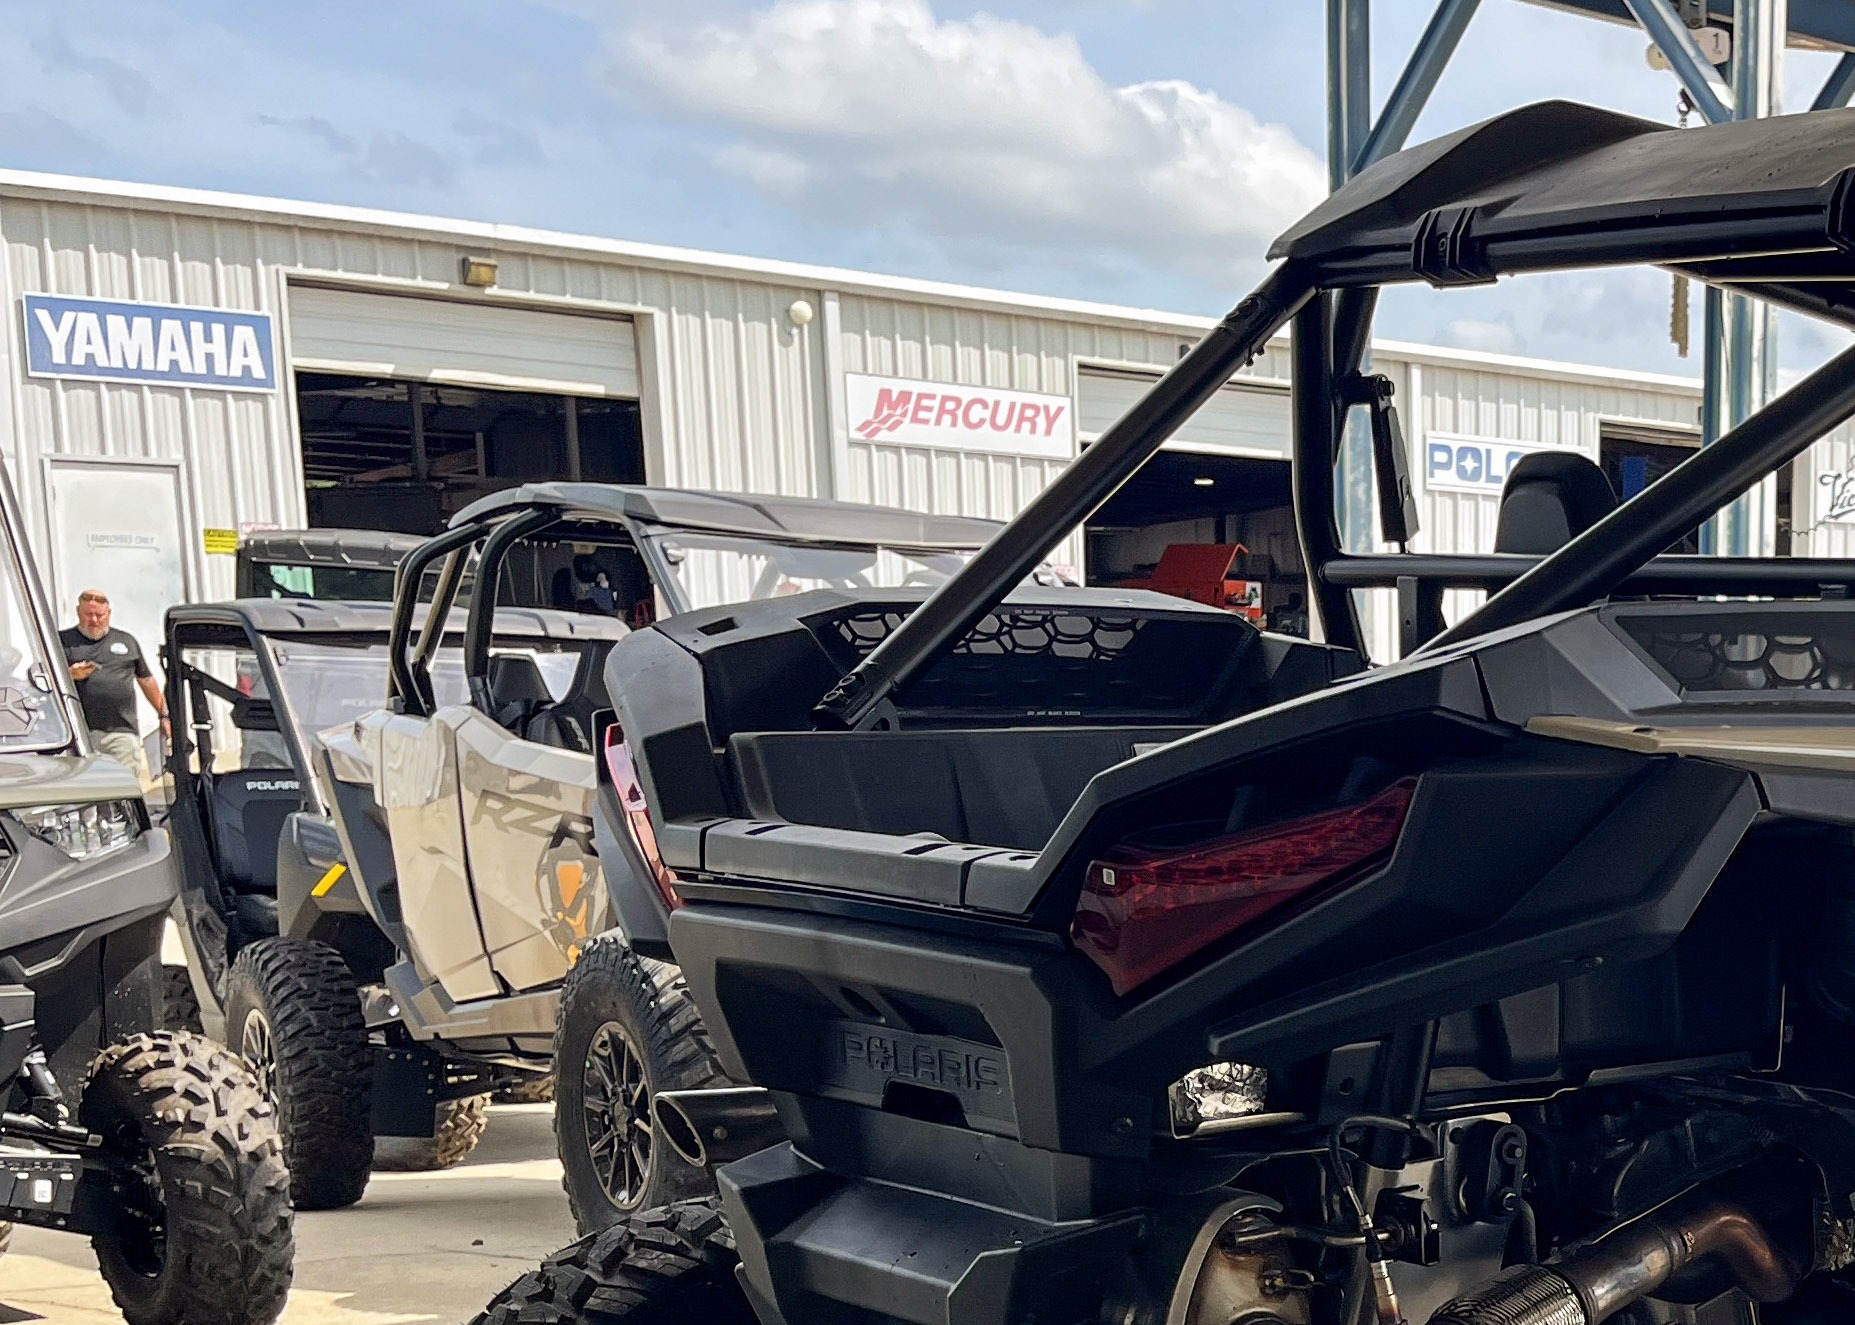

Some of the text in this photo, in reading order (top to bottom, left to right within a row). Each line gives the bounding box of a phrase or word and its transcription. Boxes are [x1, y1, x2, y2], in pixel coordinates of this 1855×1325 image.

[34, 308, 266, 379] YAMAHA
[855, 388, 1065, 439] MERCURY
[471, 789, 599, 857] RZR
[843, 1031, 999, 1091] POLARIS
